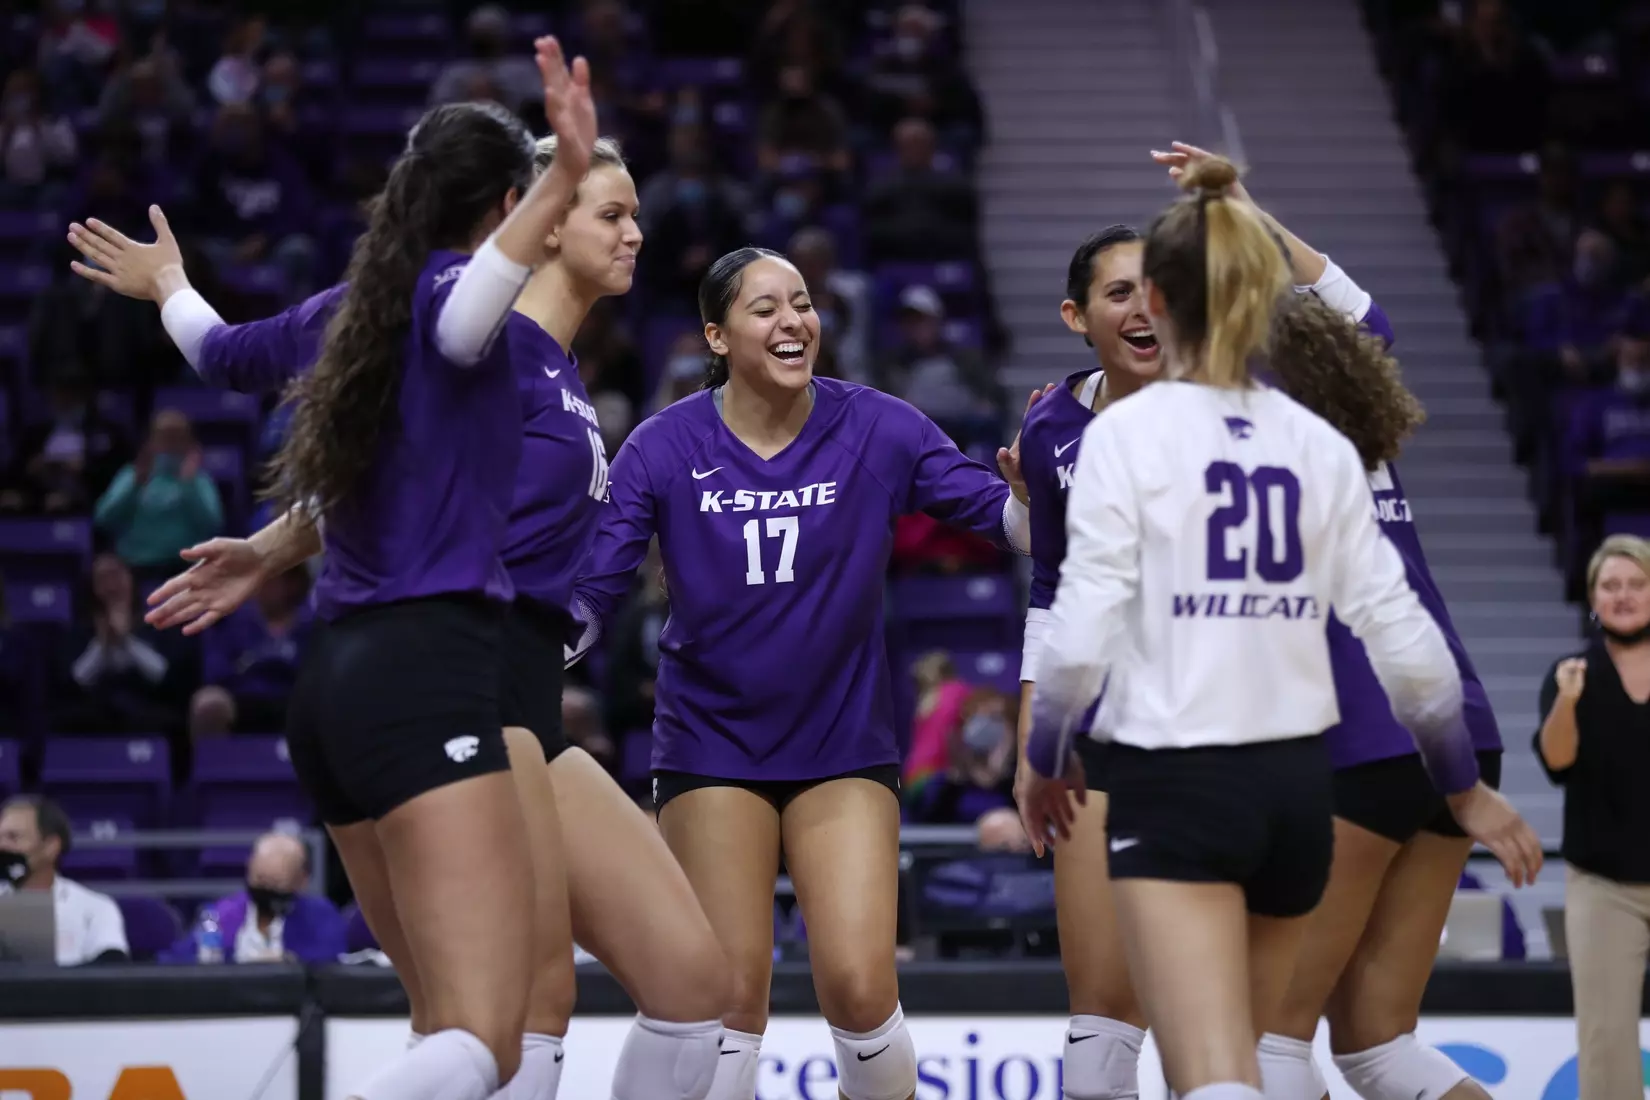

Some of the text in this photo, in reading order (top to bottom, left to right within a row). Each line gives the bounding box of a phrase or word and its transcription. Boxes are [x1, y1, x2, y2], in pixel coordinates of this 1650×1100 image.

[586, 427, 609, 502] 16
[699, 481, 837, 513] K-STATE
[743, 515, 800, 586] 17
[1204, 460, 1304, 583] 20
